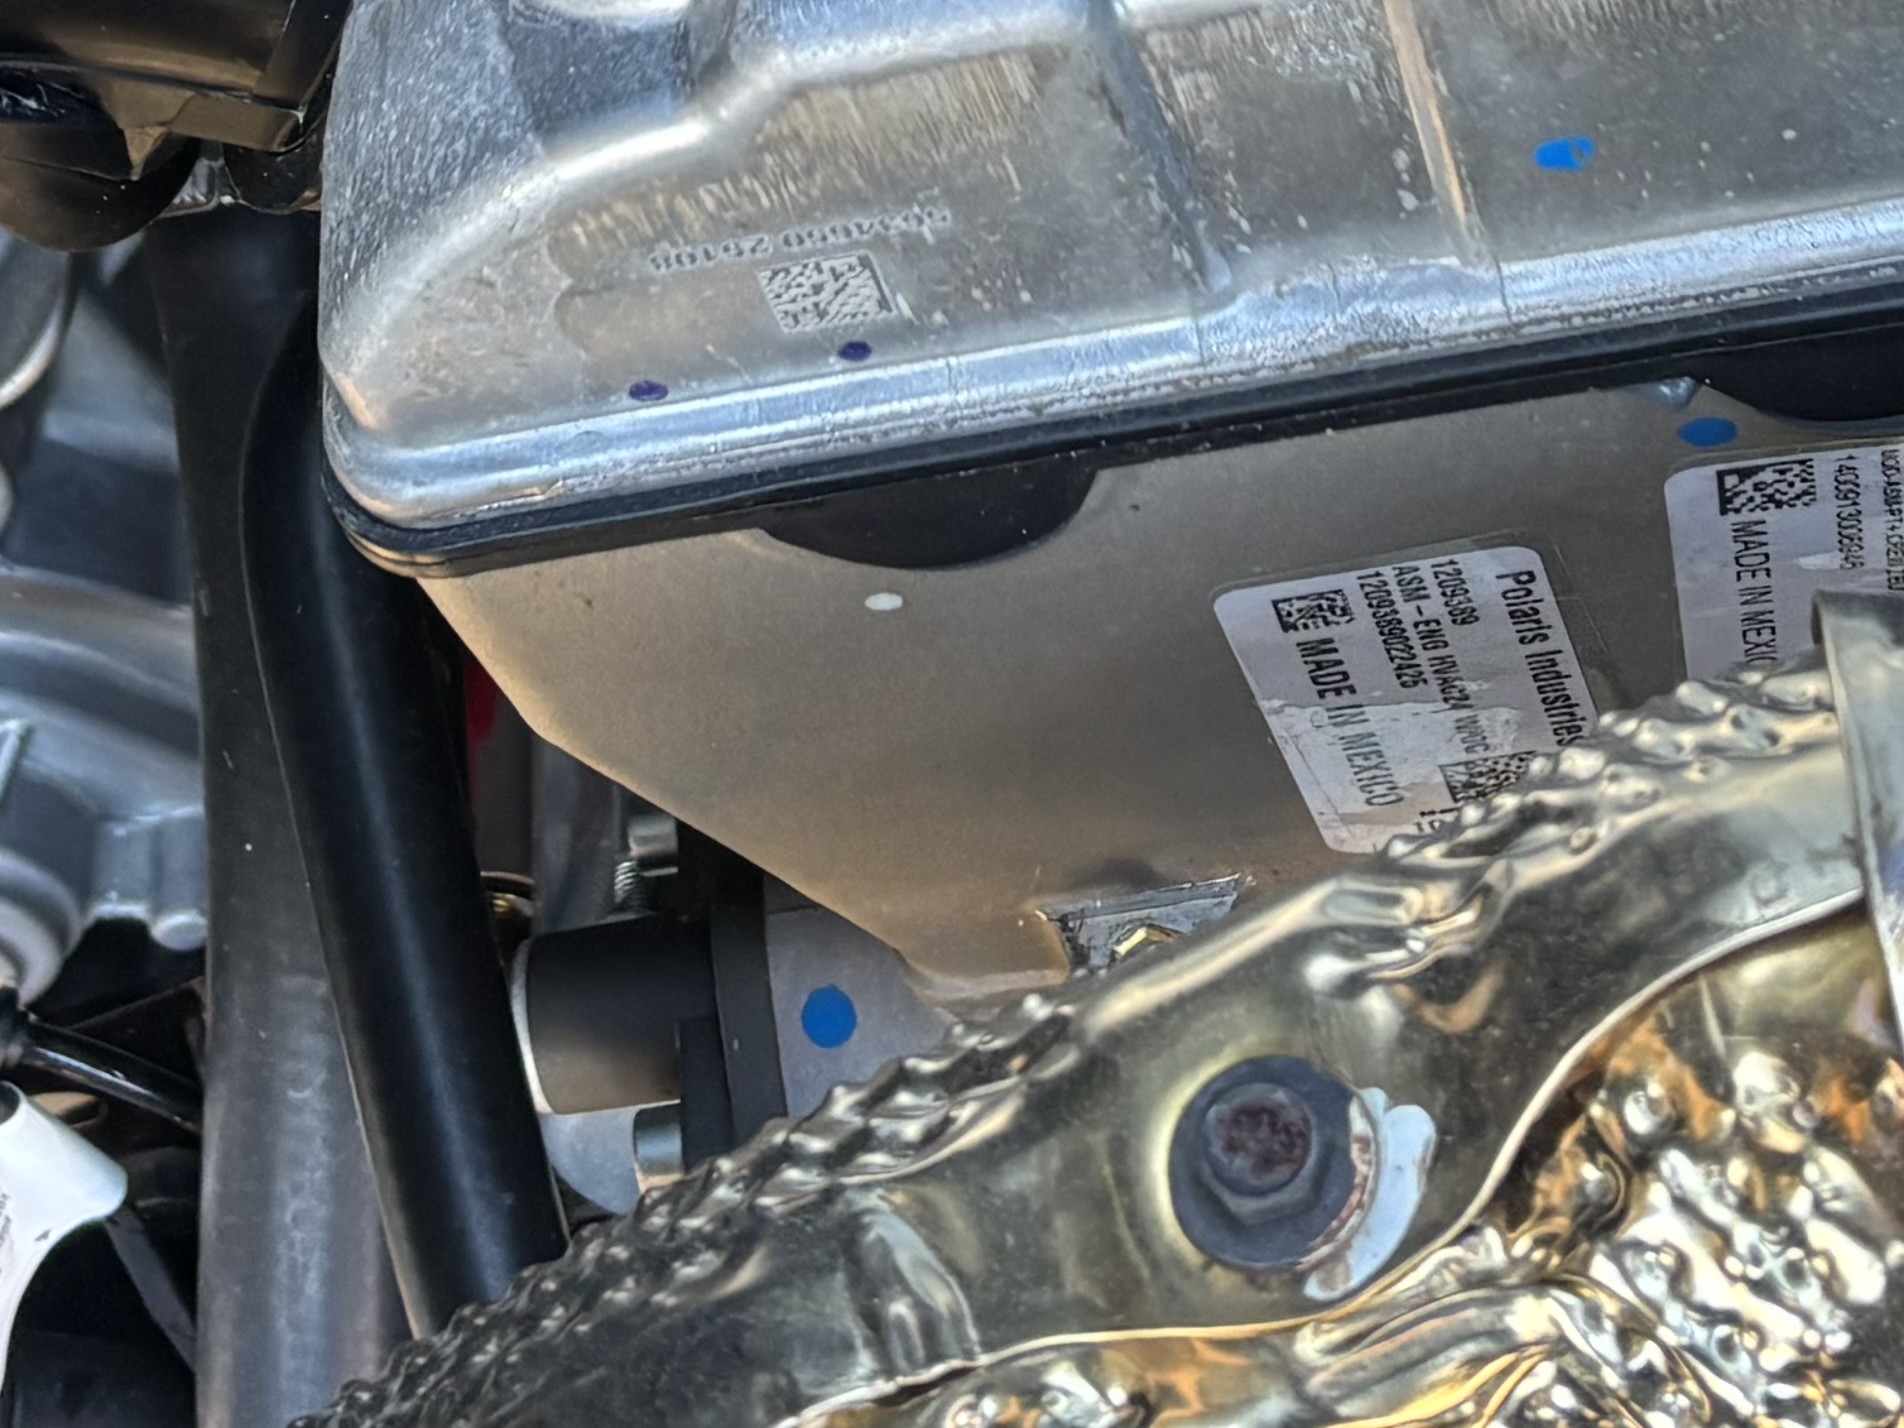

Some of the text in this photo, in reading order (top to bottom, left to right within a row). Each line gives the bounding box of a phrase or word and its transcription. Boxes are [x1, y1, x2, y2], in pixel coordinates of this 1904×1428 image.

[1493, 567, 1591, 748] Polaris Industries
[1729, 518, 1777, 666] MADE IN MEXIC
[1294, 634, 1405, 811] MADE IN MEXICO
